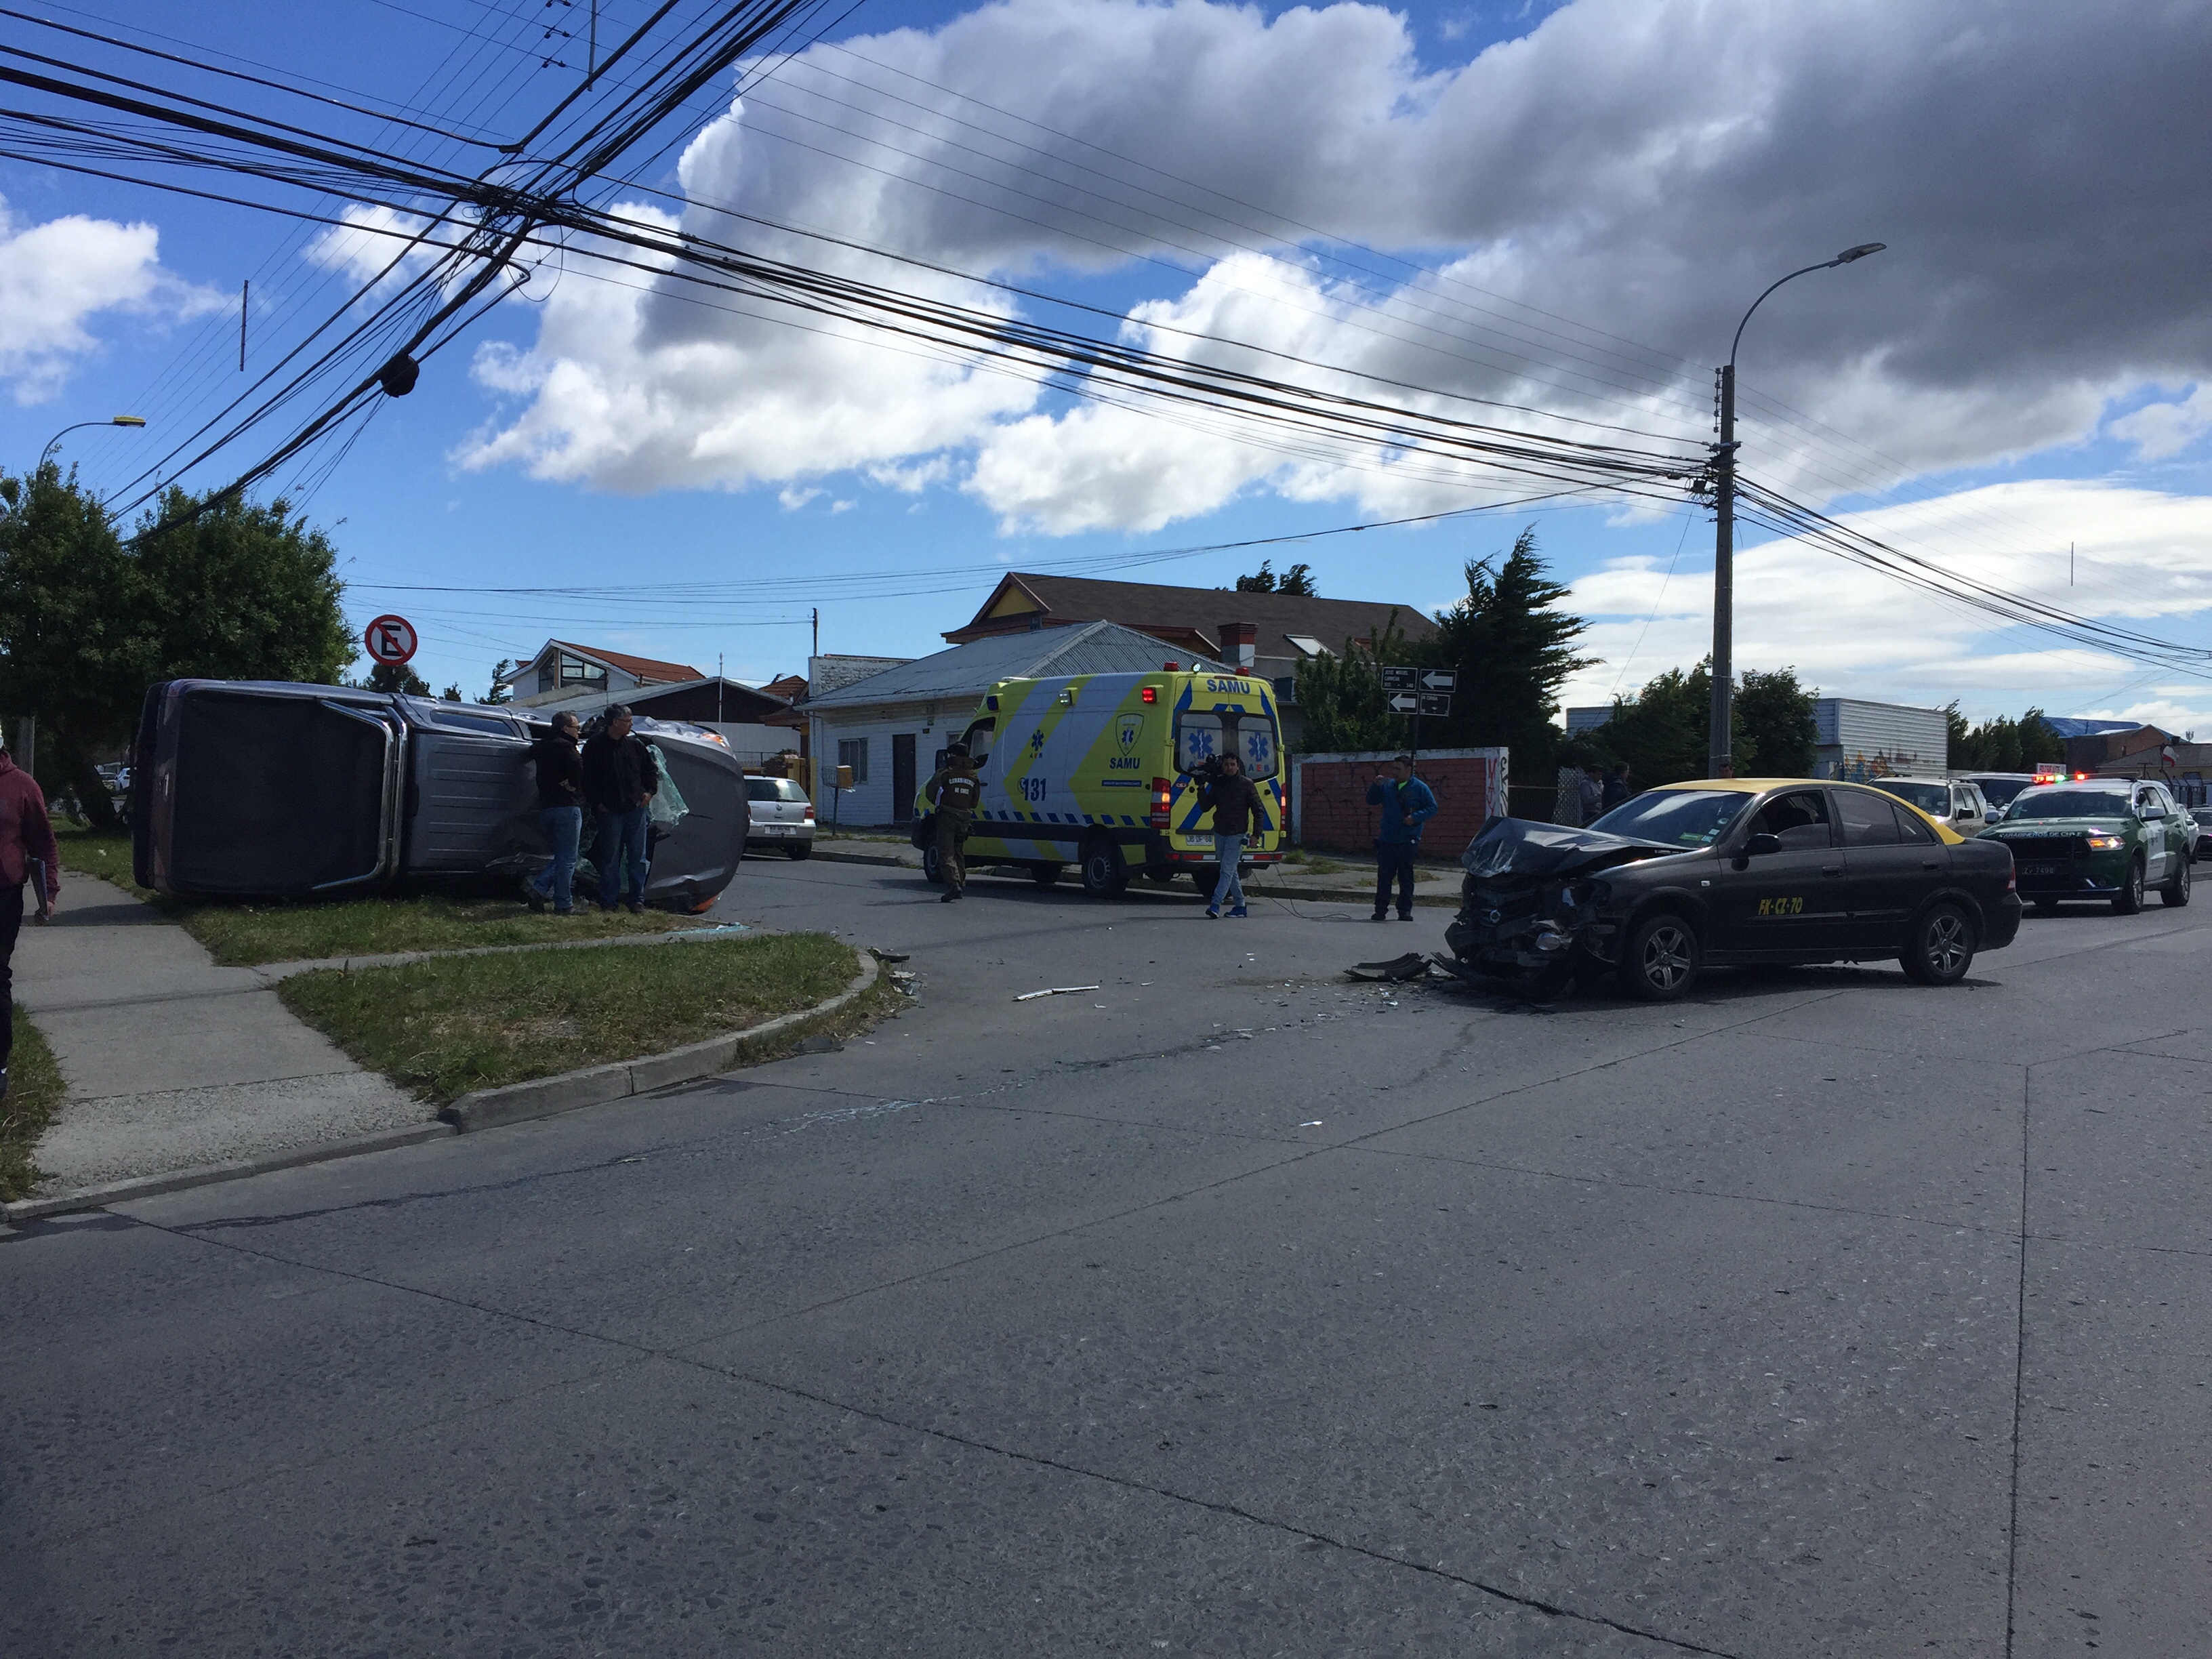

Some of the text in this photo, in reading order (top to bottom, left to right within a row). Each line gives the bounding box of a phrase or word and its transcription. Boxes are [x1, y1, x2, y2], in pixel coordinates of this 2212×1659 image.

[1206, 678, 1250, 695] SAMU
[1109, 757, 1141, 769] SAMU
[1023, 778, 1046, 801] 131
